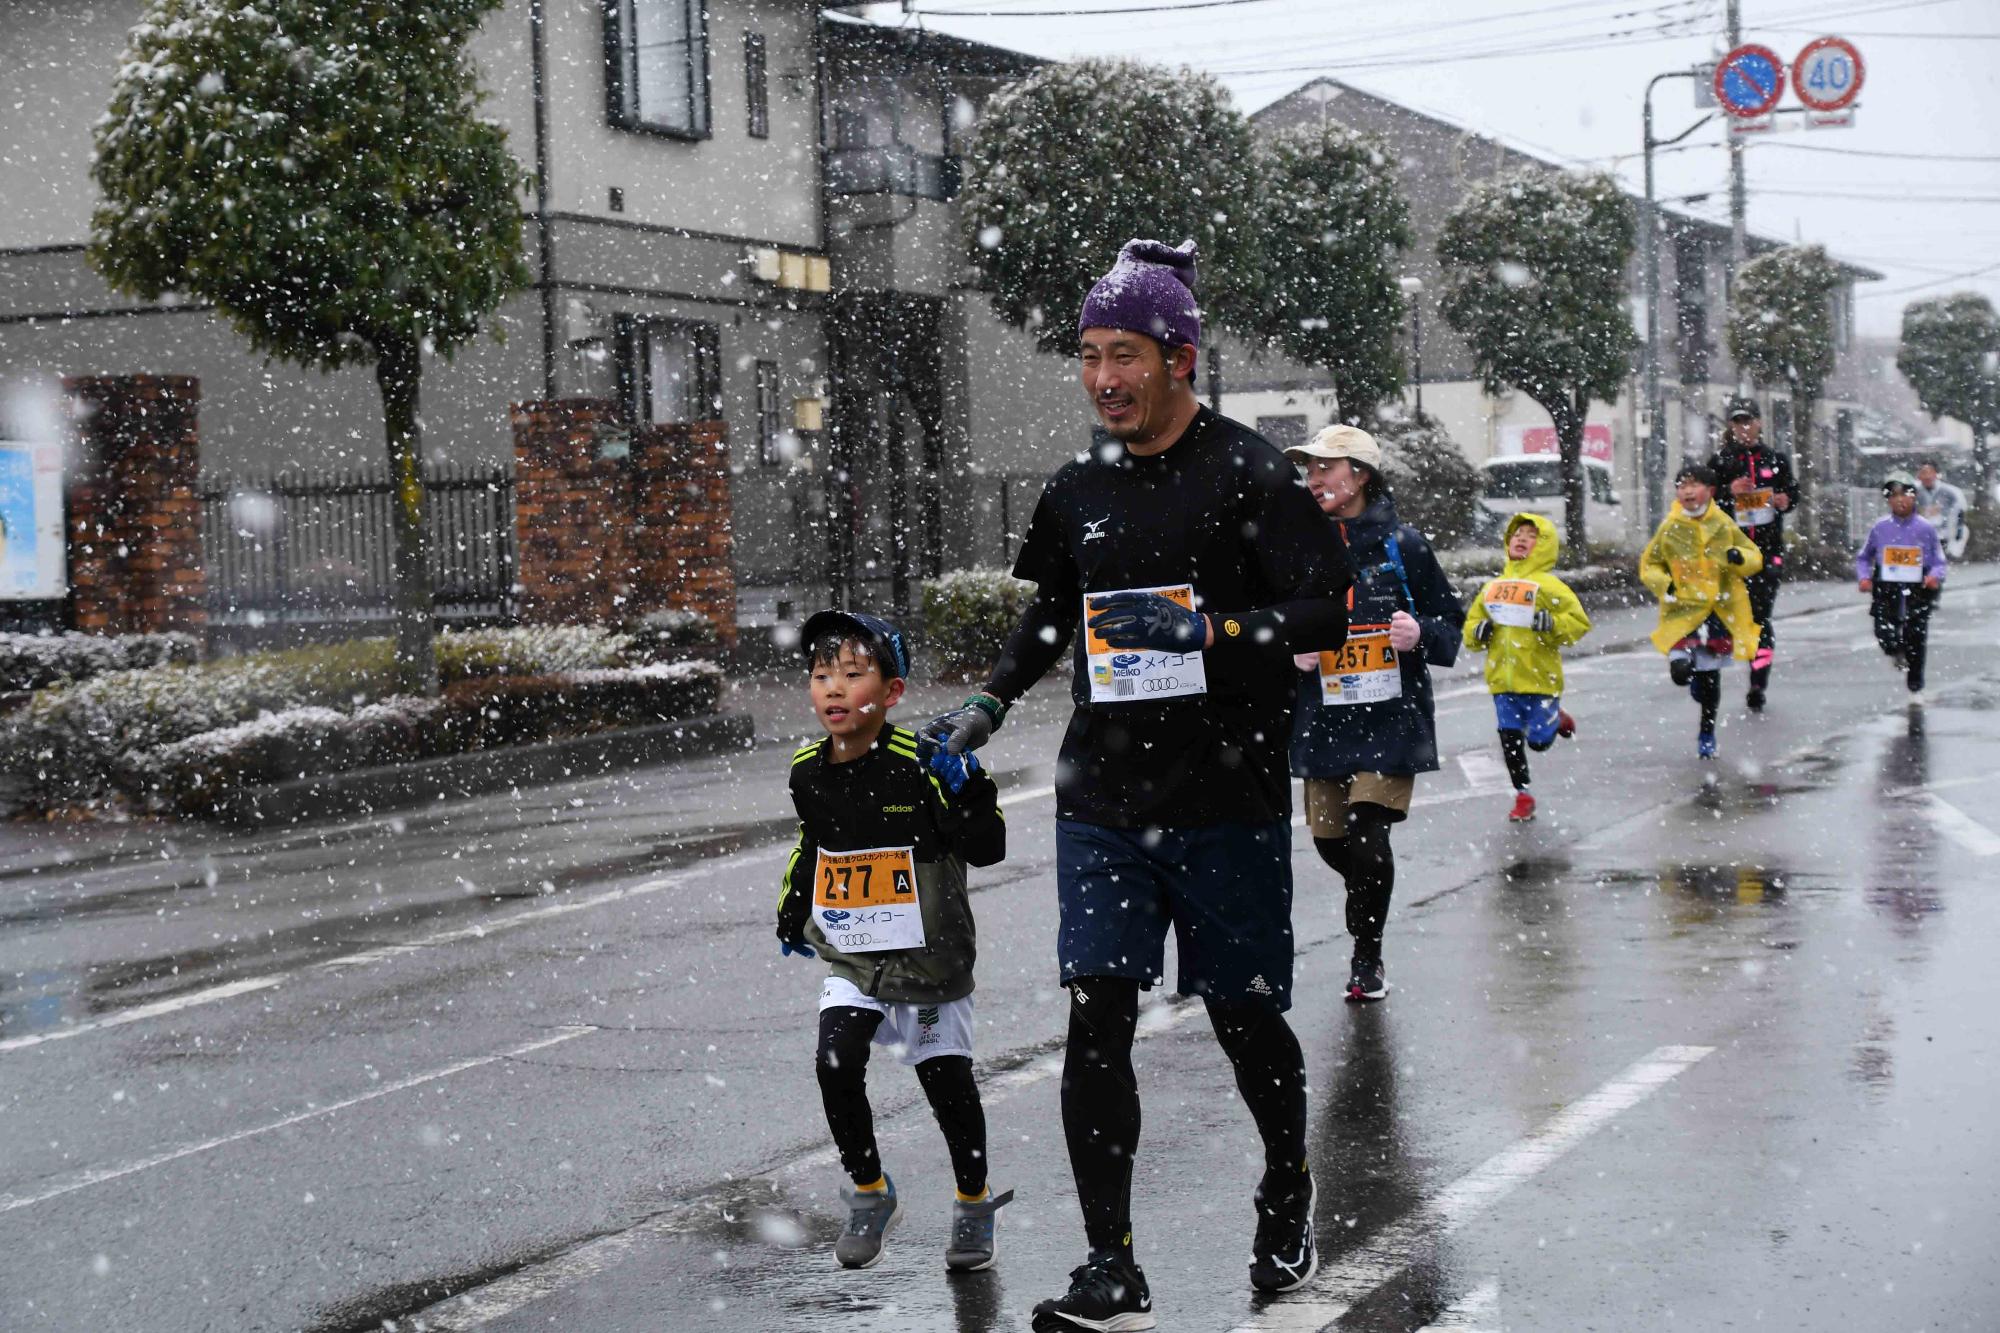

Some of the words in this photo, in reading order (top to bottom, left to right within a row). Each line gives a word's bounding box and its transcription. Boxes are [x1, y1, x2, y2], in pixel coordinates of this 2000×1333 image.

[1809, 56, 1849, 90] 40
[1494, 585, 1519, 601] 257
[1144, 655, 1199, 669] メイコー
[1334, 644, 1369, 669] 257
[1113, 668, 1141, 677] MEIKO
[882, 804, 913, 812] adidas
[824, 864, 873, 899] 277
[896, 874, 909, 890] A
[854, 911, 905, 925] メイコー
[826, 922, 851, 931] MEIKO
